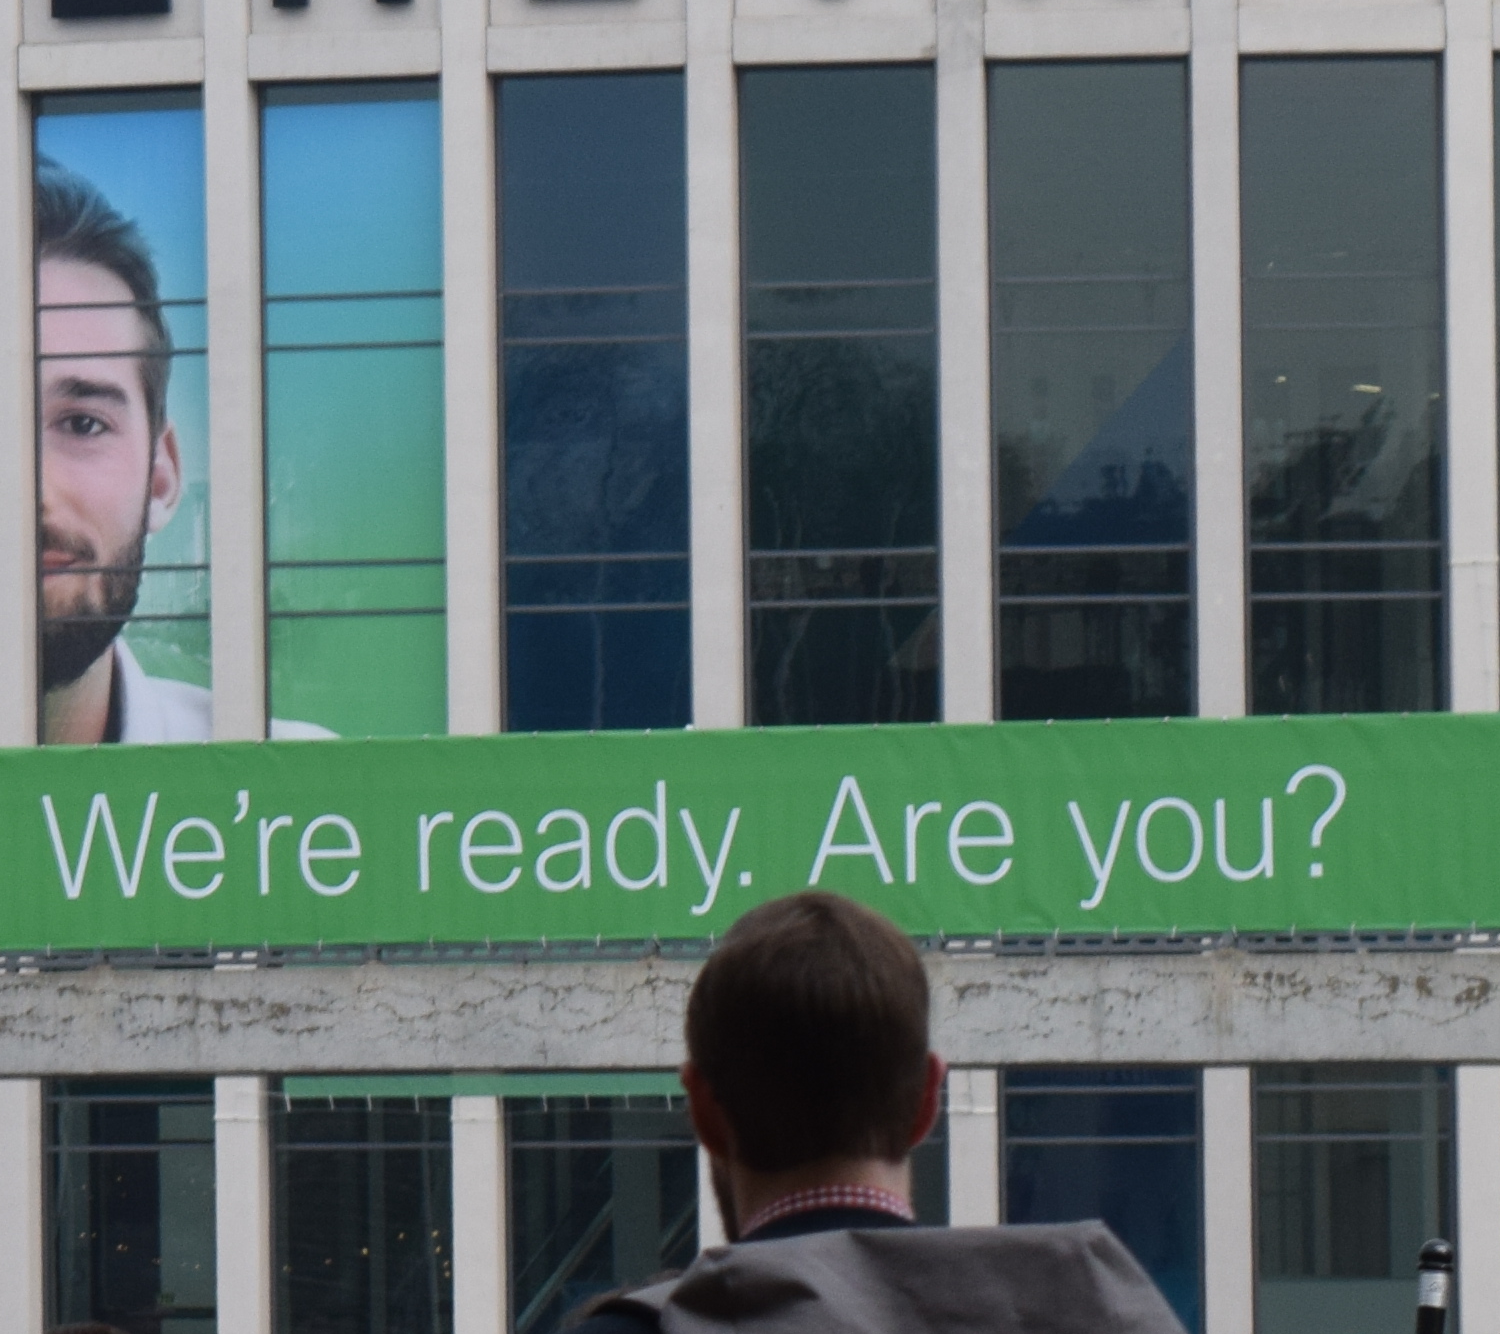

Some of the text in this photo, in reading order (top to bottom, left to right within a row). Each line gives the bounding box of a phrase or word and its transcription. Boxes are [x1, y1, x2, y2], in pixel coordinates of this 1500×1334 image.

[42, 765, 1347, 916] We're ready. Are you?
